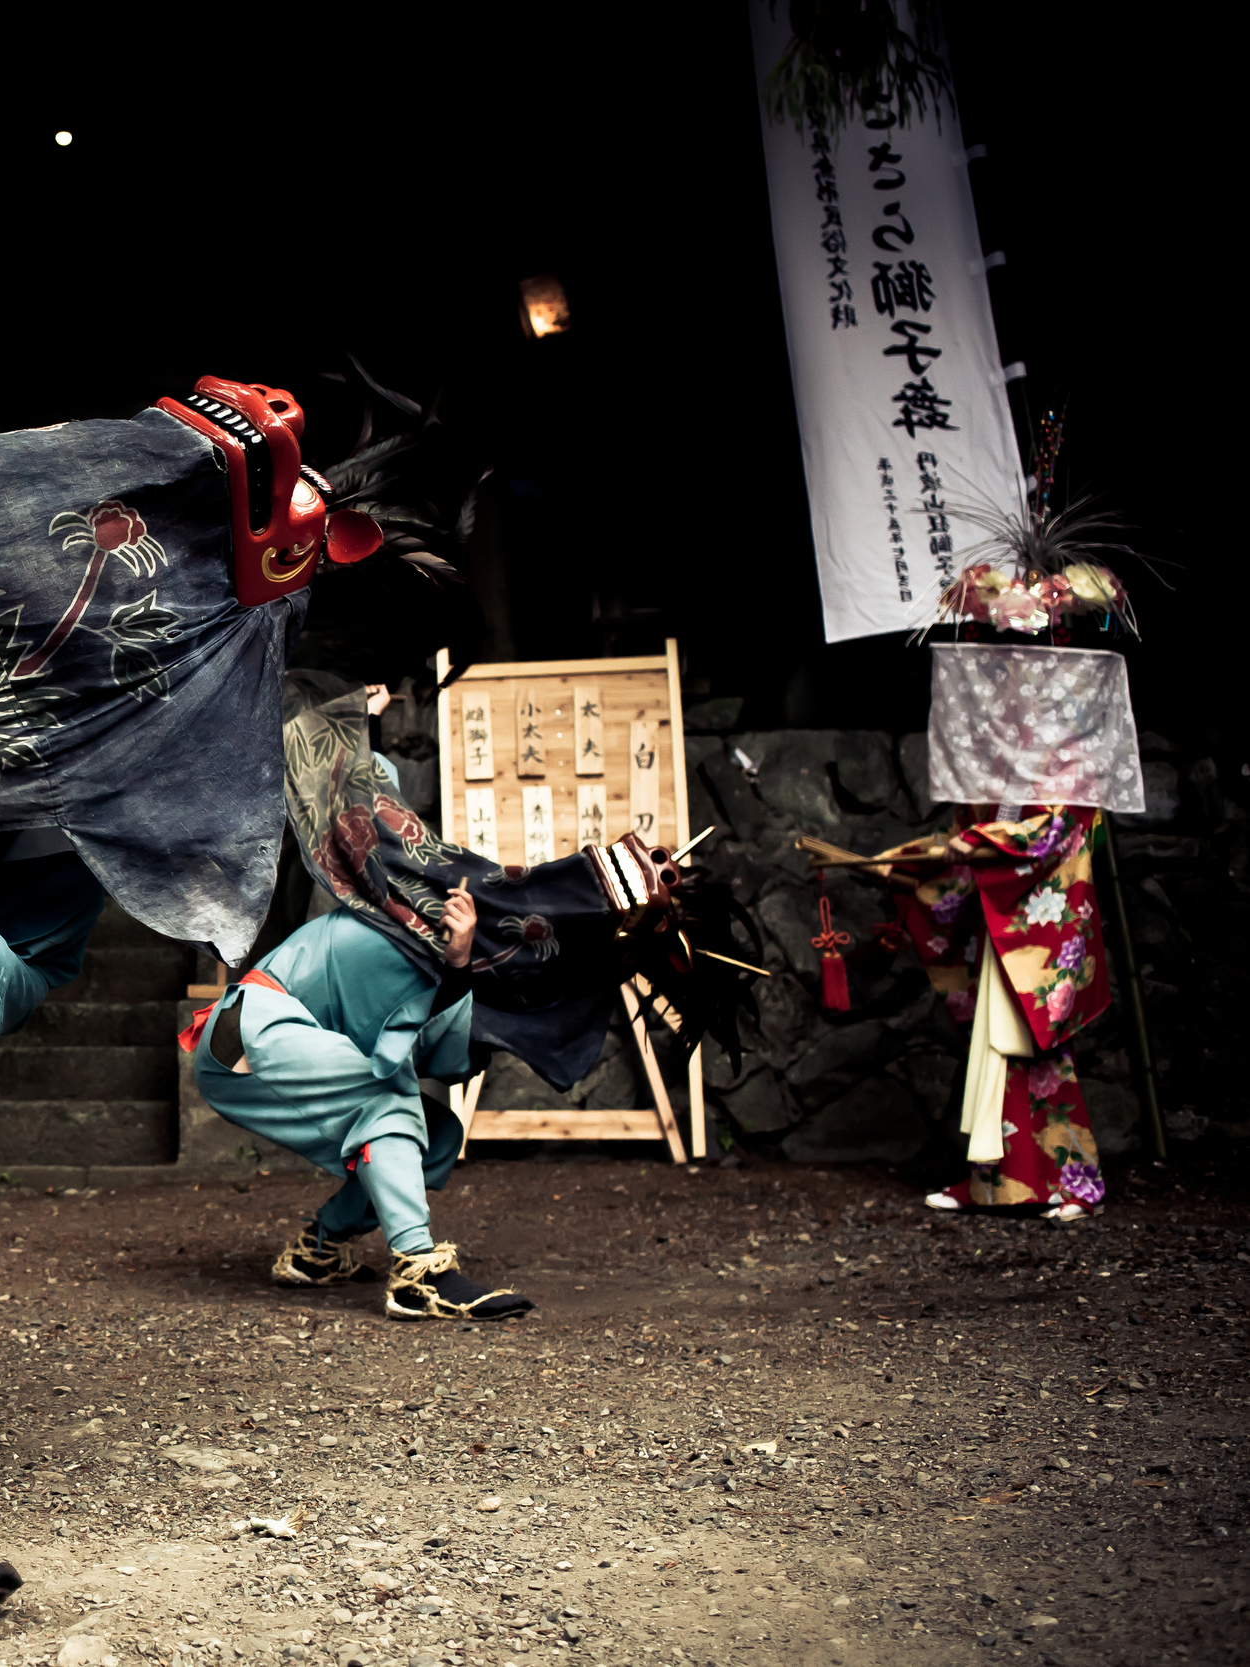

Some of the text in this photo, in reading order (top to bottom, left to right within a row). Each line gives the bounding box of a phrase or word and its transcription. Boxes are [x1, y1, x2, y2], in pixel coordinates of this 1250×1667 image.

[520, 702, 545, 763] 小太夫
[580, 700, 602, 758] 太夫
[473, 808, 494, 861] 山本
